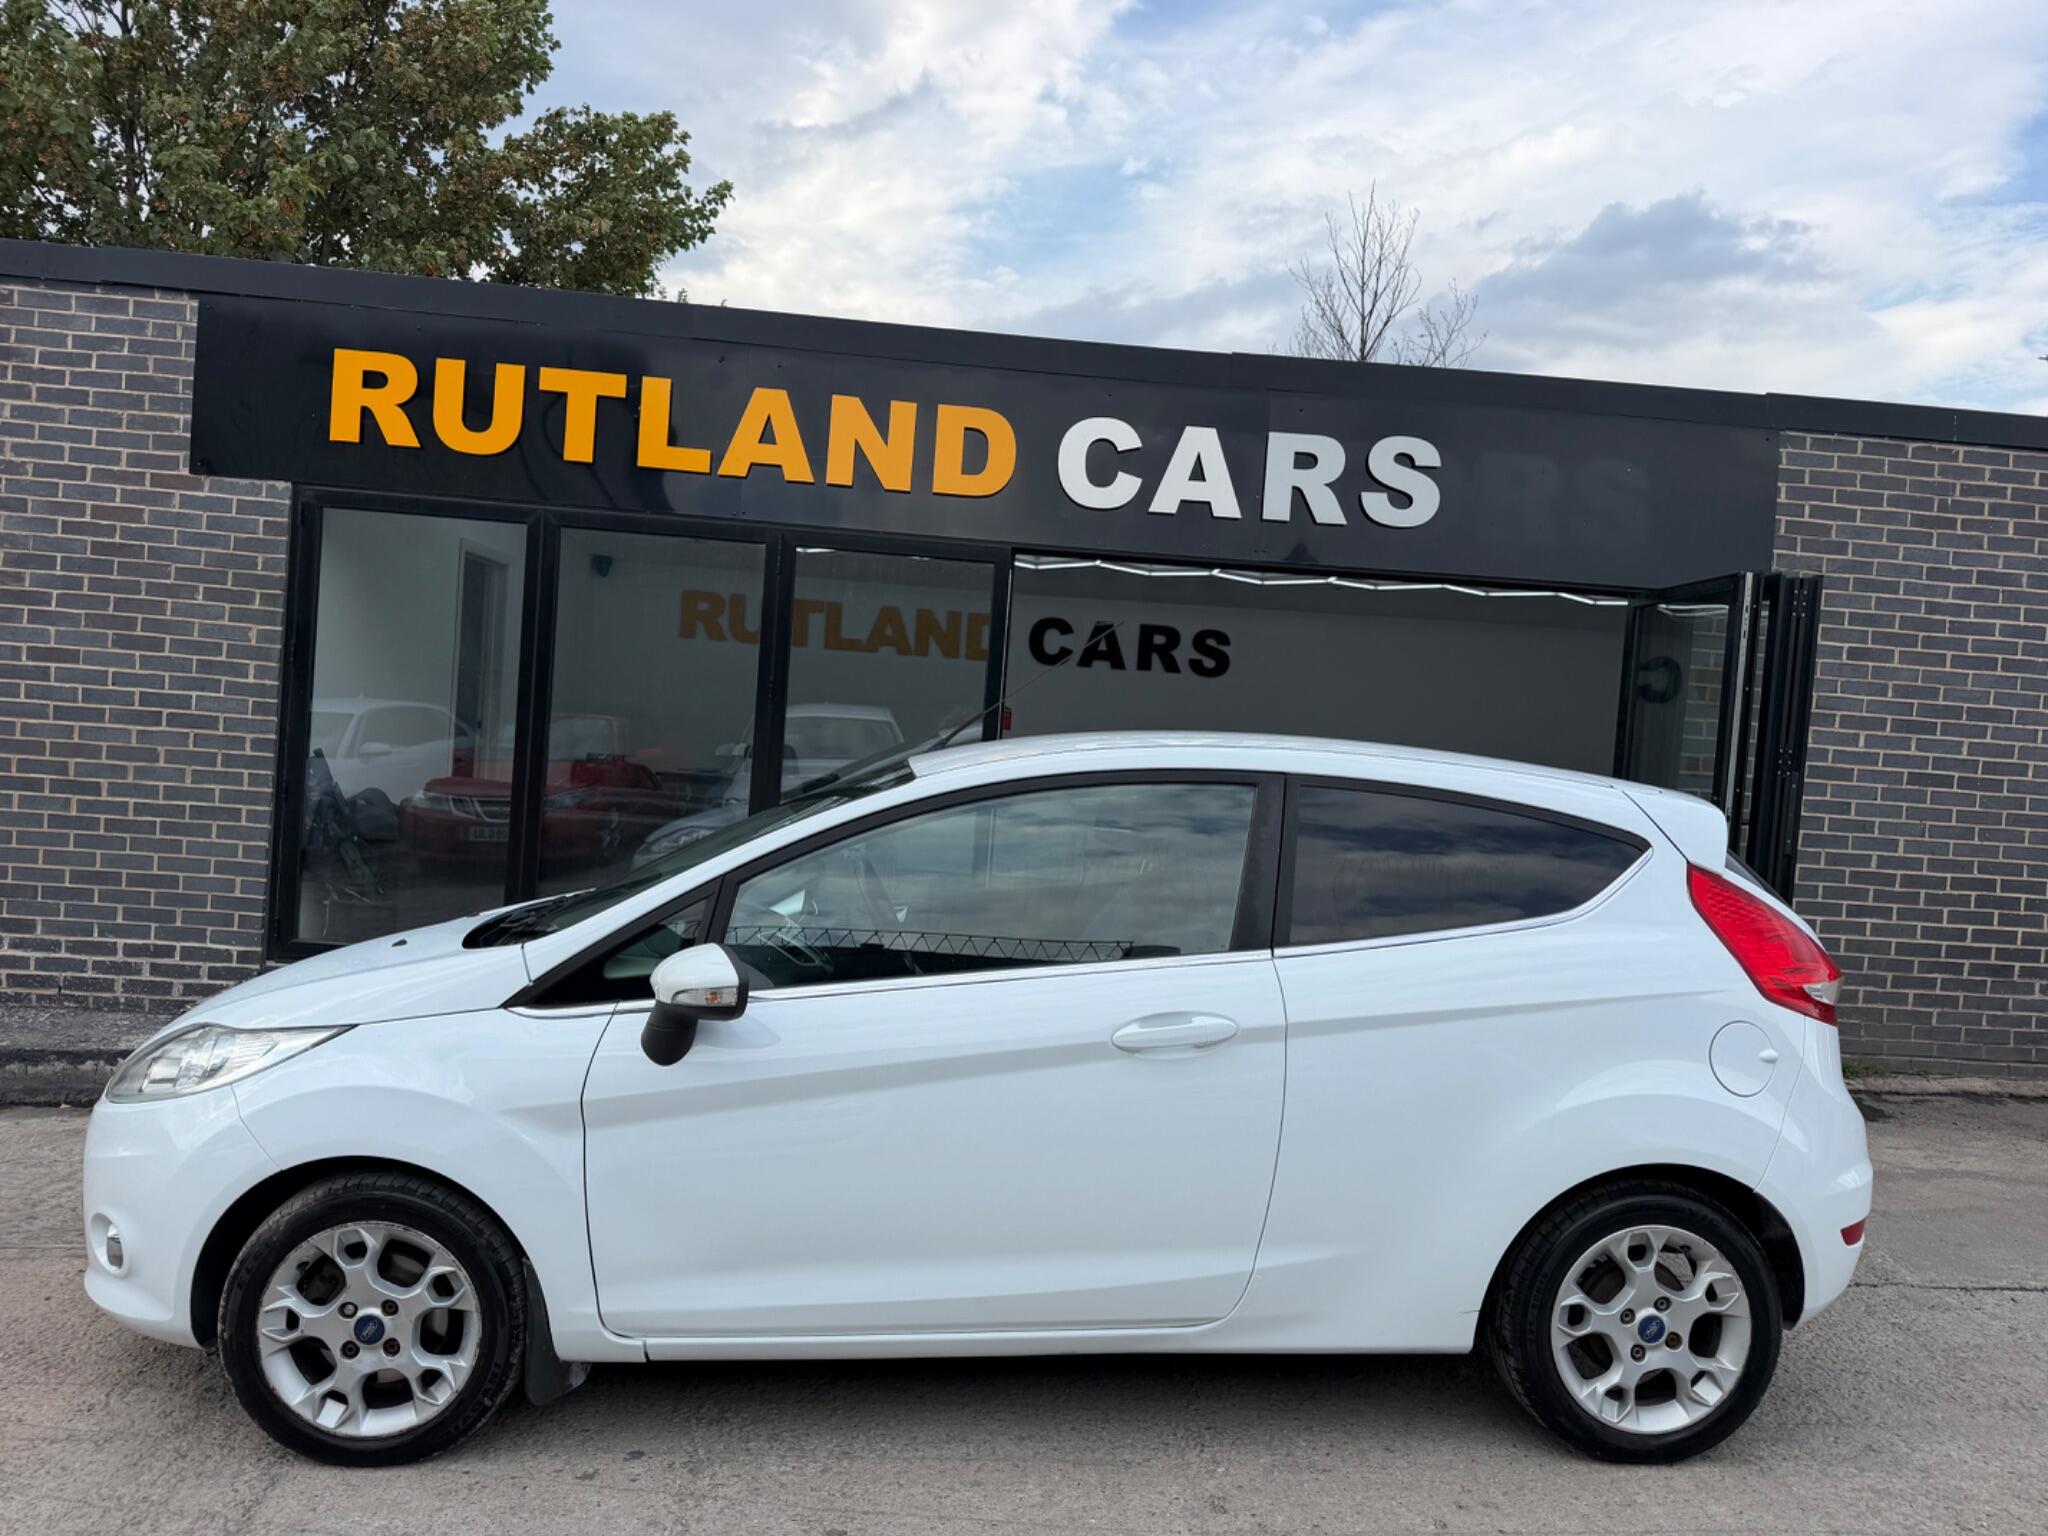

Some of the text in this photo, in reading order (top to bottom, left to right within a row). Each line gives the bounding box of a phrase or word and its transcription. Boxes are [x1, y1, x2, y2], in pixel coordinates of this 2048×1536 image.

[329, 347, 1442, 528] RUTLAND CARS
[1028, 616, 1232, 678] CARS
